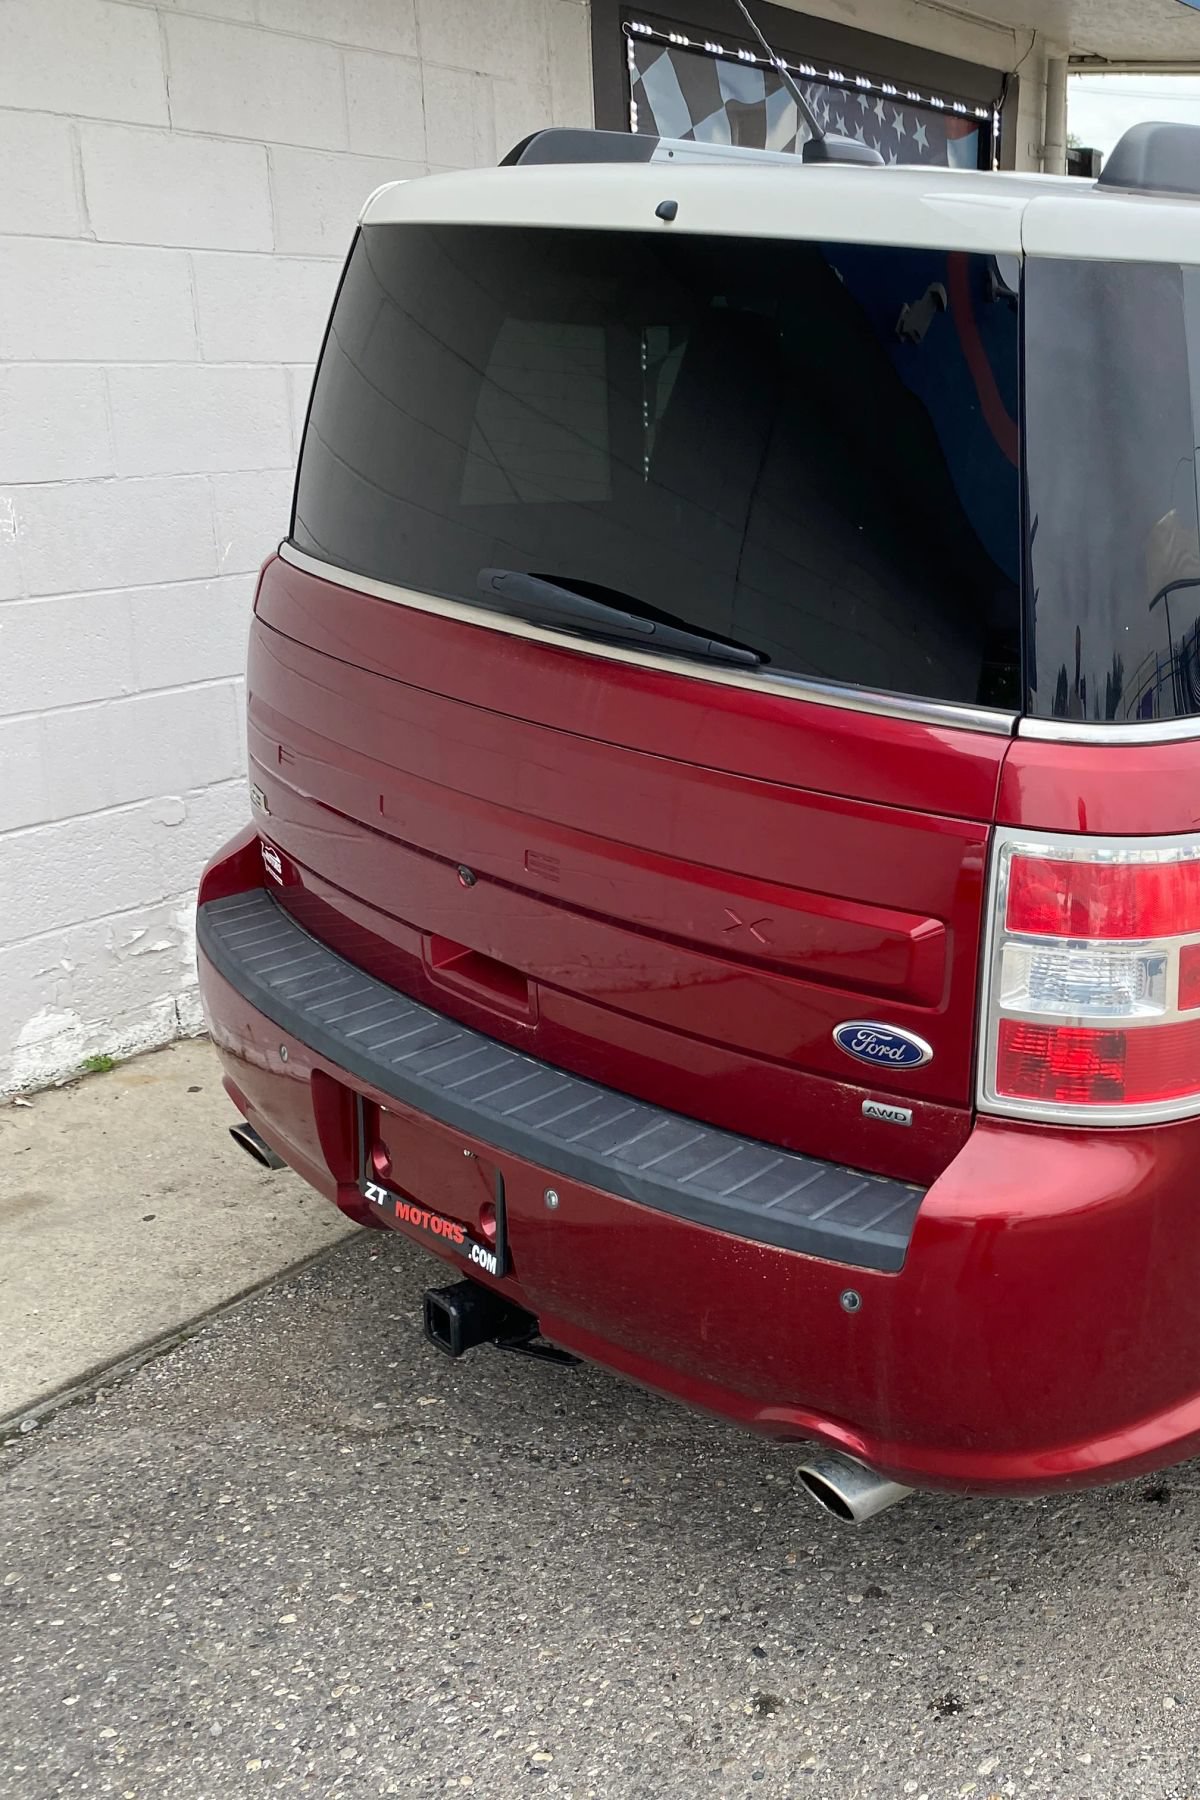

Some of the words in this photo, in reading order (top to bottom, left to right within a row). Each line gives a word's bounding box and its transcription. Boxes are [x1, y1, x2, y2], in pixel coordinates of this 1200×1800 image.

[851, 1029, 905, 1061] Ford
[866, 1106, 907, 1121] AWD
[364, 1182, 387, 1205] ZT
[395, 1201, 465, 1244] MOTORS
[468, 1244, 497, 1275] .COM
